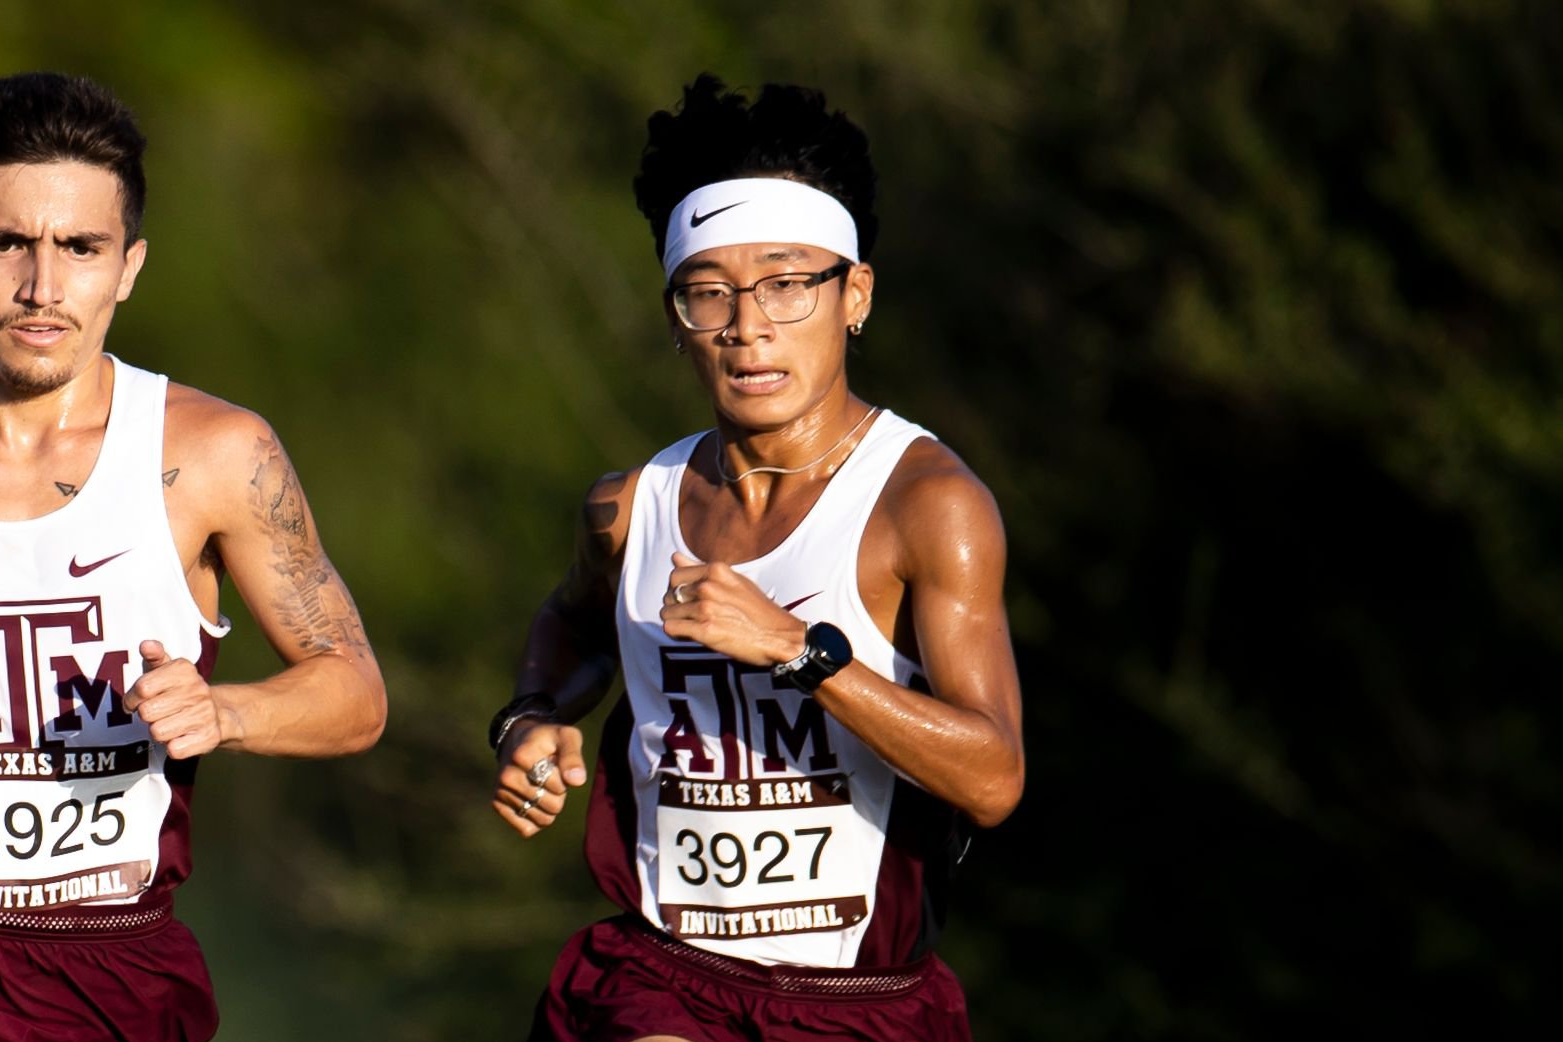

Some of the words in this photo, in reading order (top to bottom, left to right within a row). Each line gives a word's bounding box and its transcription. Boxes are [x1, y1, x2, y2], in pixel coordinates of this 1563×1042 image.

[63, 751, 117, 775] A&M
[678, 781, 751, 807] TEXAS
[759, 781, 814, 806] A&M
[676, 826, 833, 889] 3927
[679, 904, 844, 936] INVITATIONAL
